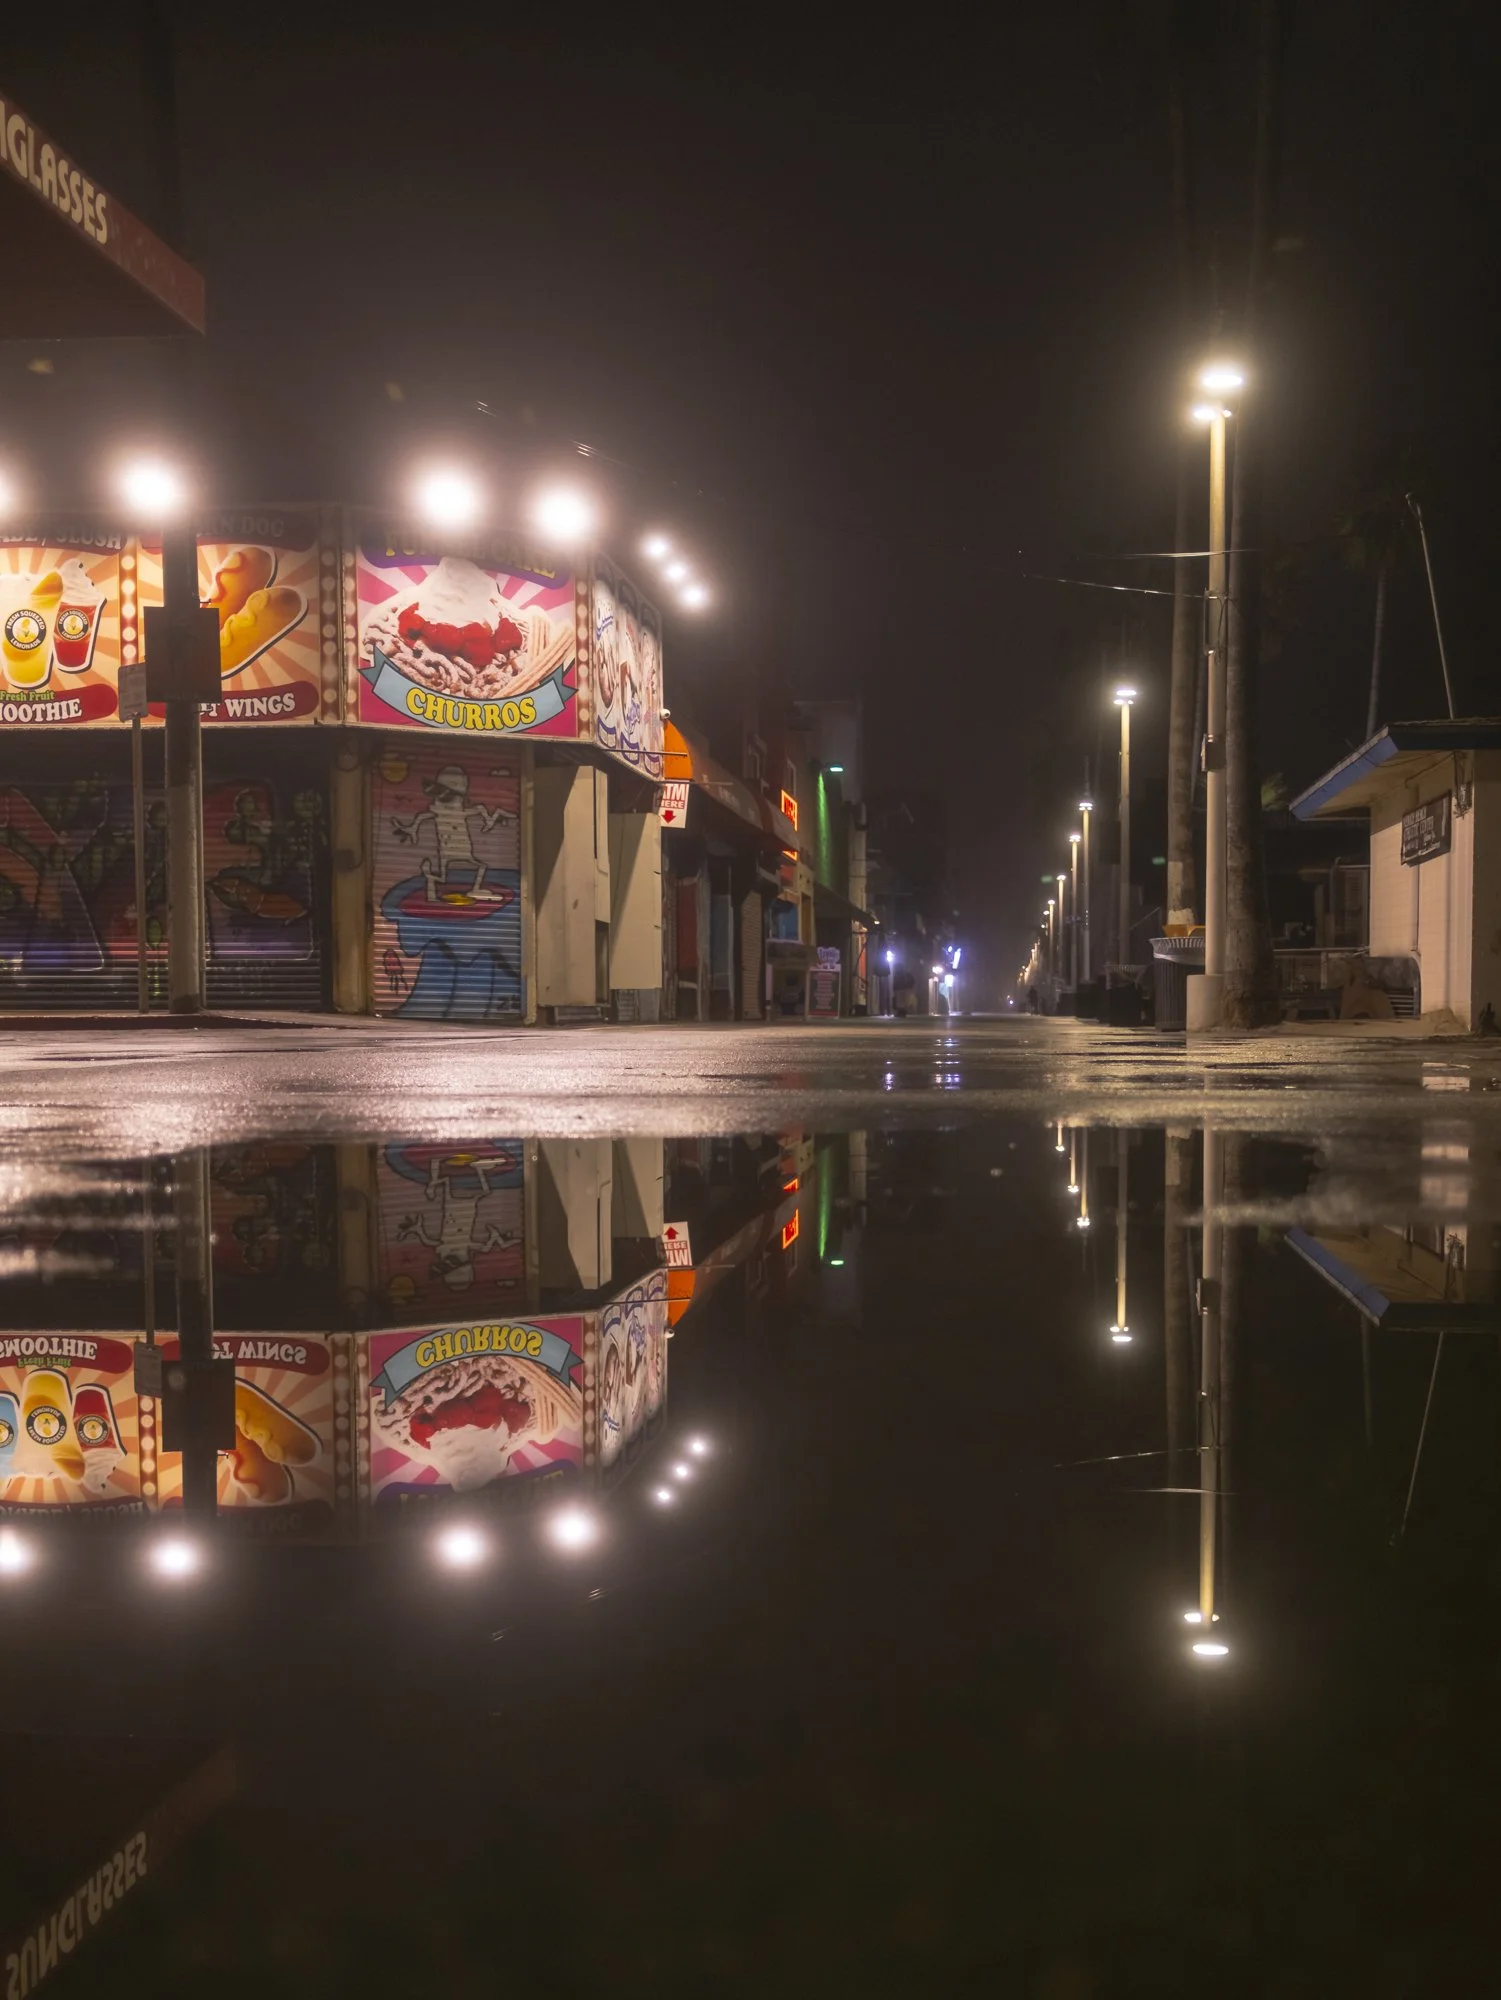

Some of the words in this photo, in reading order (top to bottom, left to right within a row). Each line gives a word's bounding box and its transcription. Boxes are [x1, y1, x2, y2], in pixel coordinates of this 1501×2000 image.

[7, 611, 20, 629] FRESH
[10, 638, 41, 650] LEMONADE
[0, 690, 27, 701] Fresh
[29, 690, 56, 701] Fruit
[223, 692, 296, 718] WINGS
[406, 688, 536, 731] CHURROS
